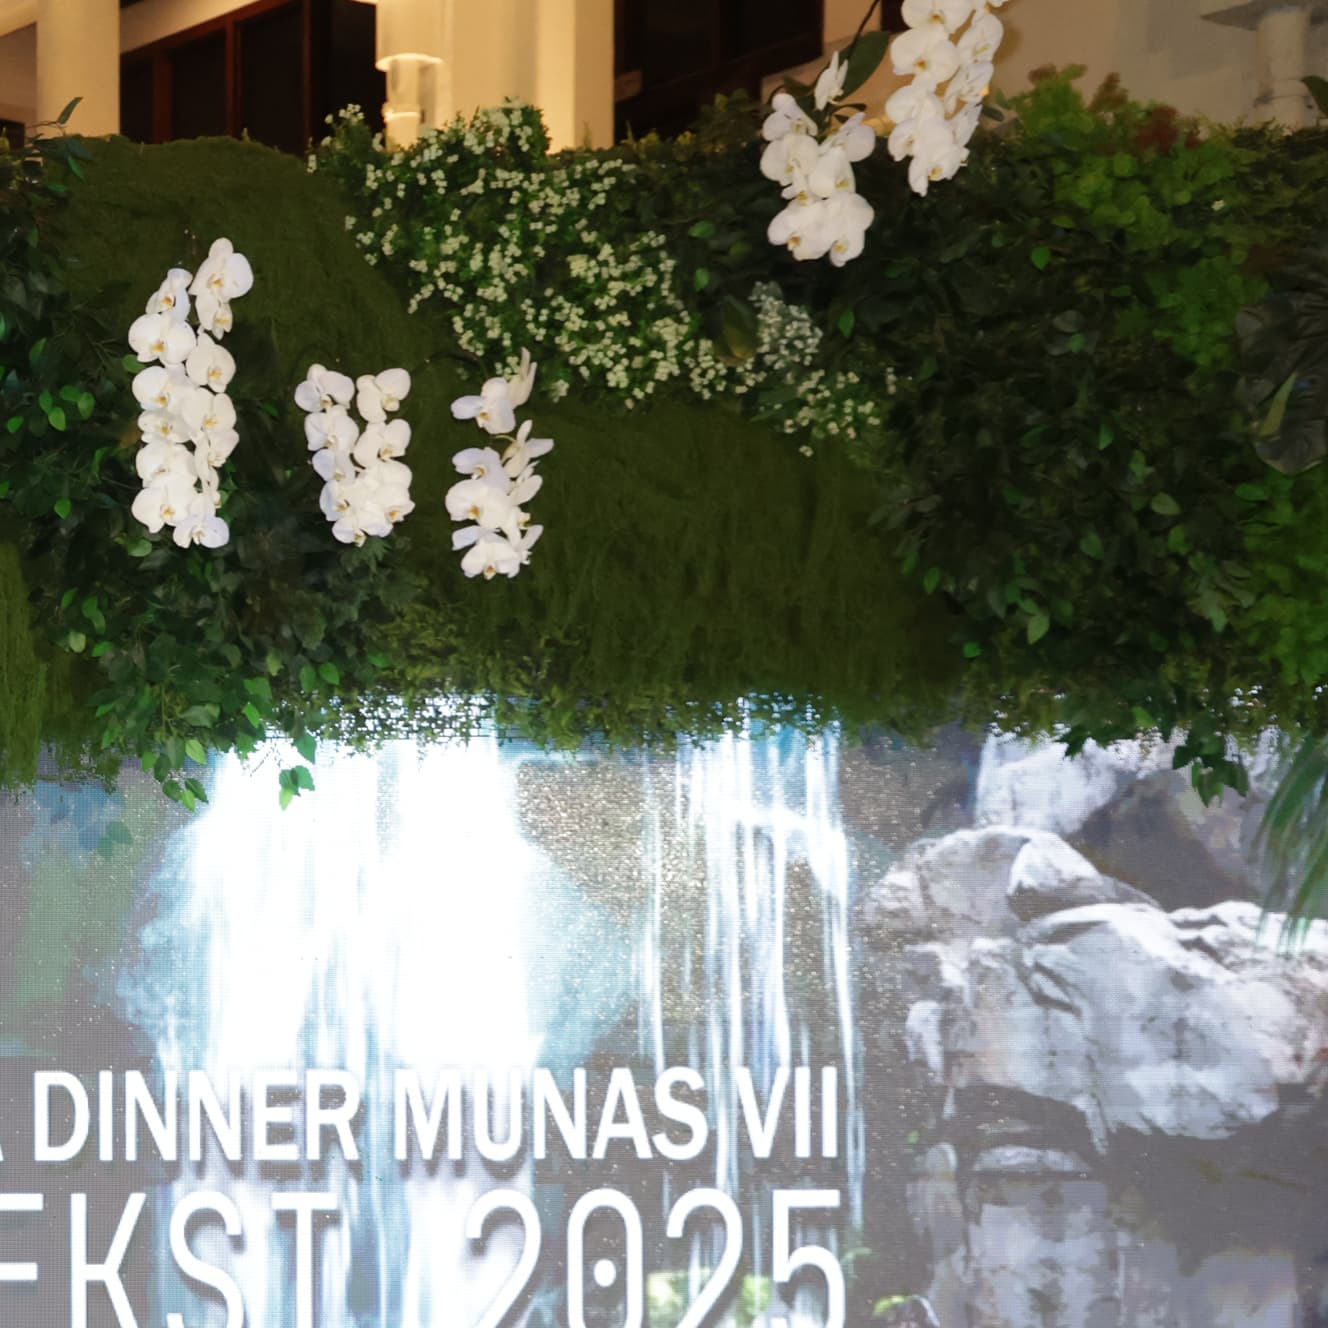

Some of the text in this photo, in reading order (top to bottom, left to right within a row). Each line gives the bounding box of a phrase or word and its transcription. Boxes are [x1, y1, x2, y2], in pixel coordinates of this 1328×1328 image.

[34, 1069, 362, 1163] DINNER
[394, 1066, 708, 1162] MUNAS
[733, 1065, 840, 1160] VII
